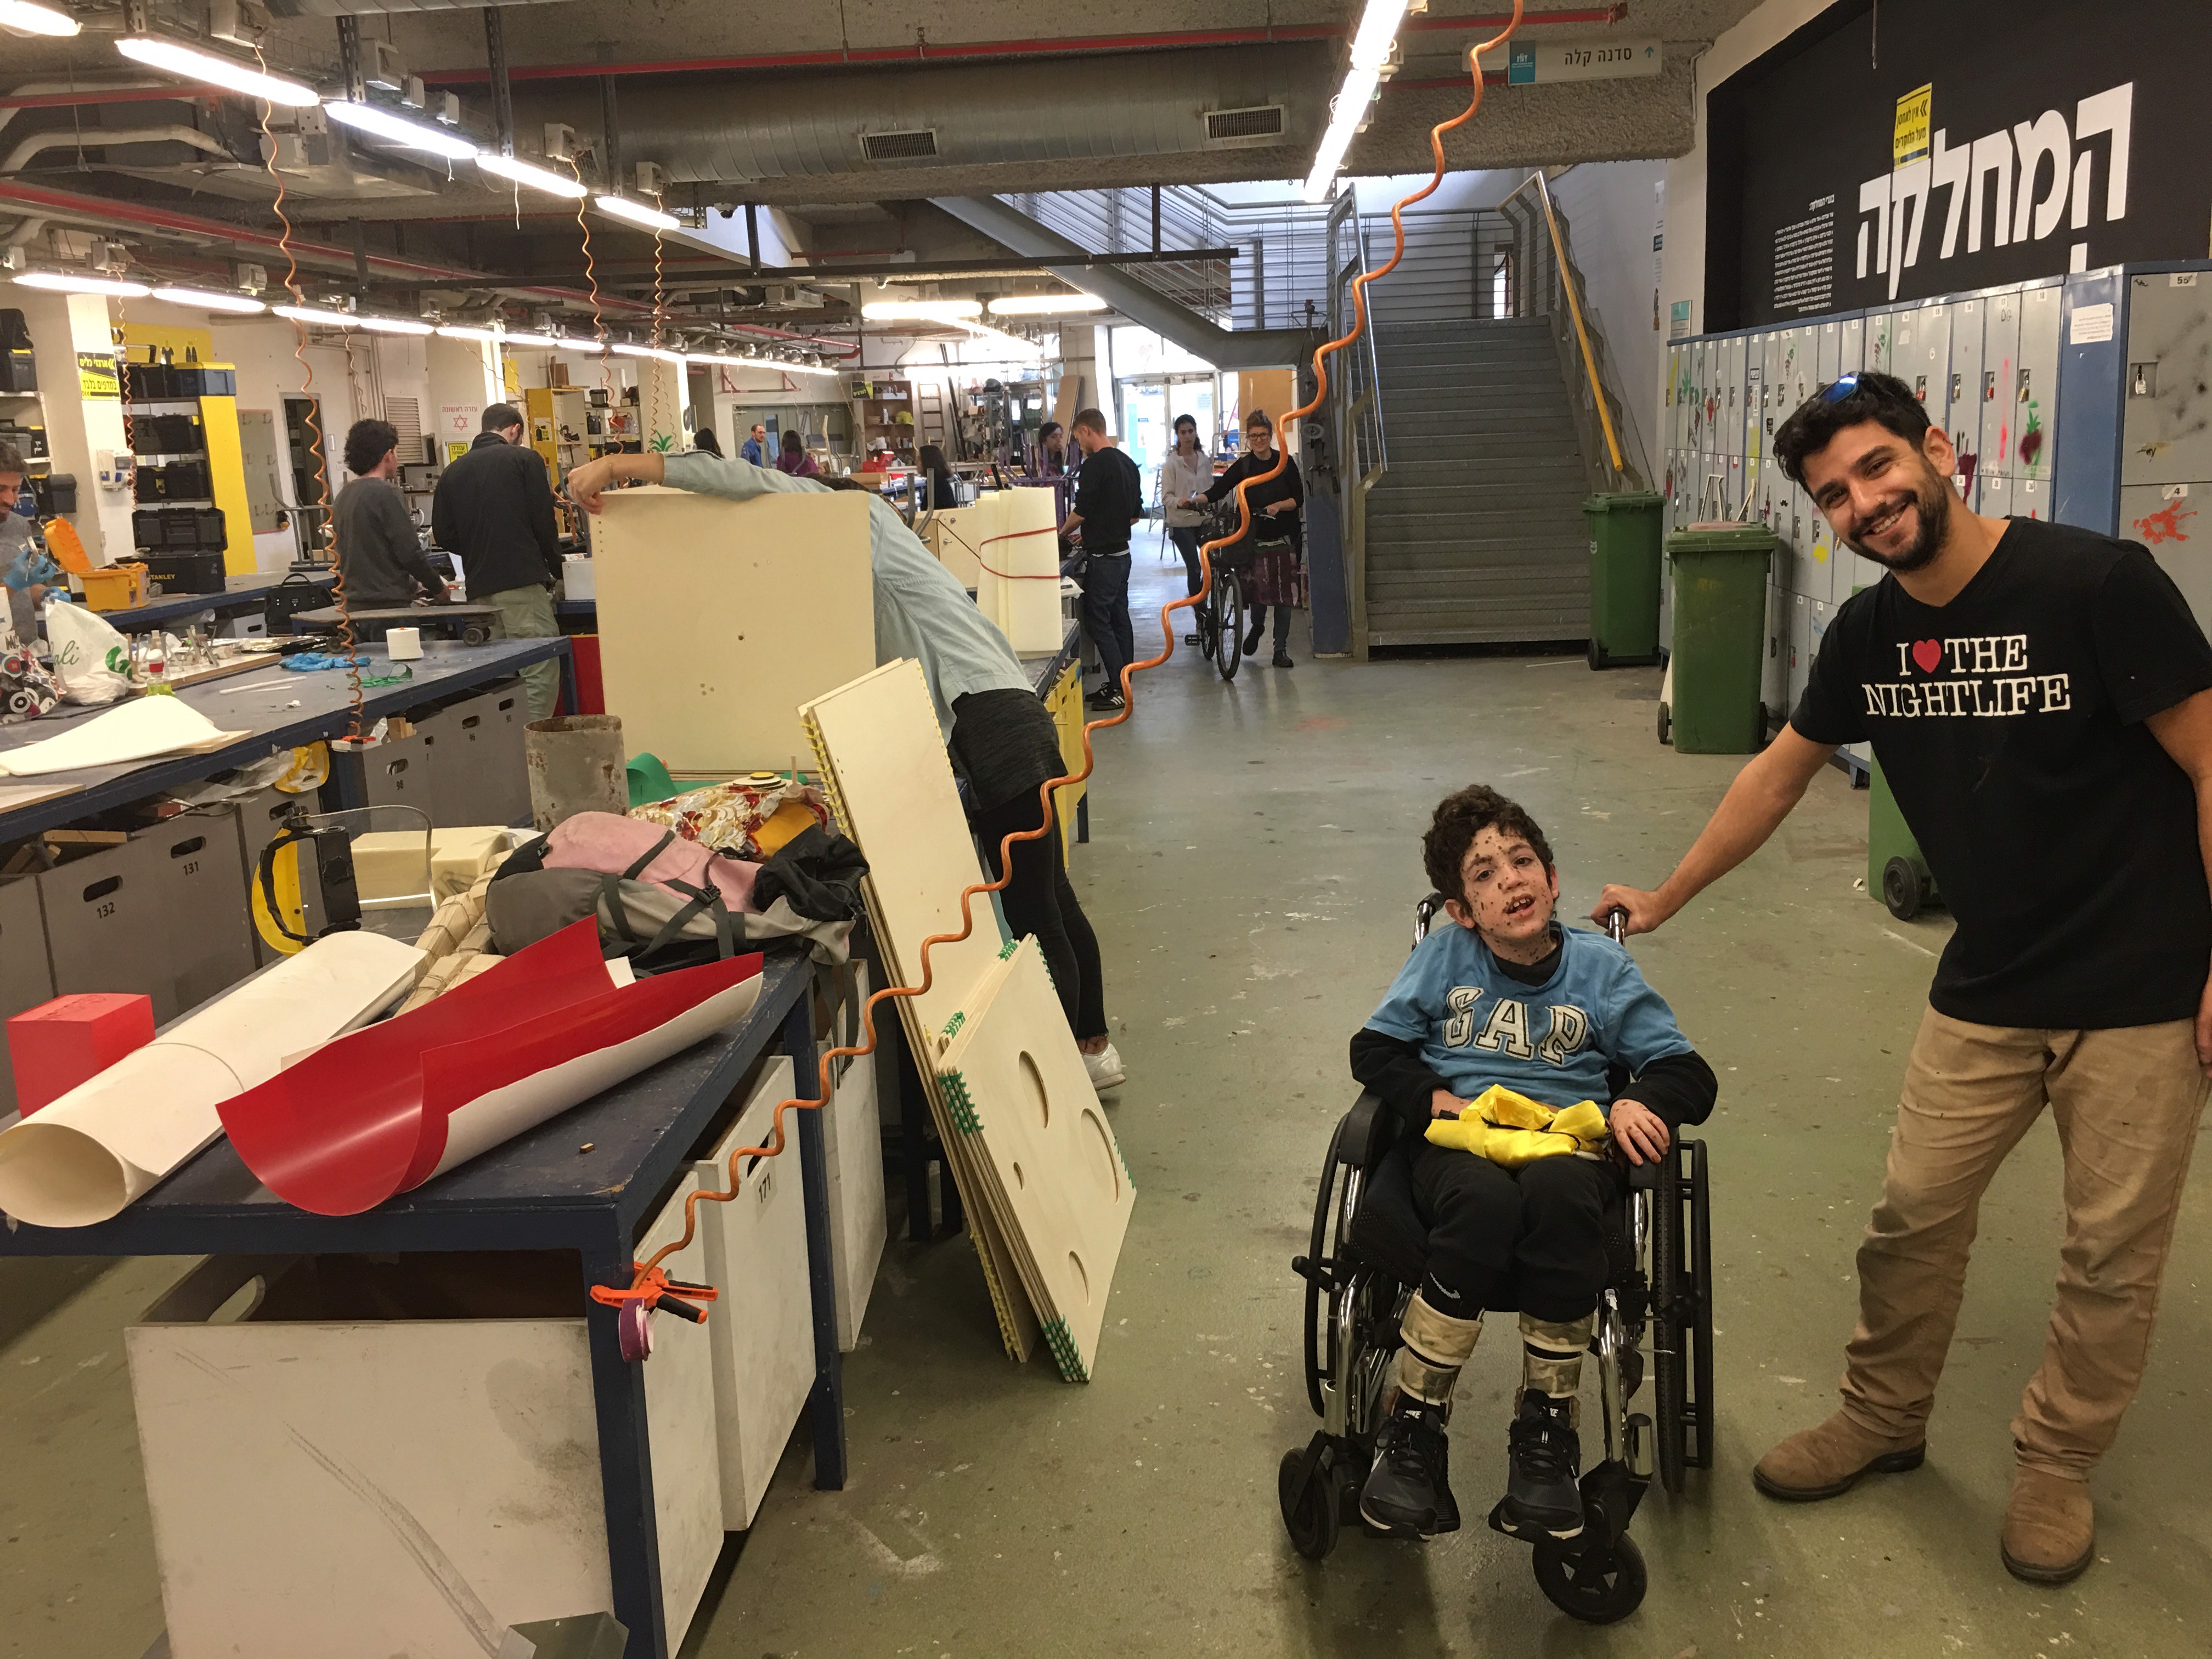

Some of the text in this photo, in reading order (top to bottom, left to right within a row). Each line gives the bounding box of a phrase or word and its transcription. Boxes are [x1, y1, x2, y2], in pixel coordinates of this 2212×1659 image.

[1565, 48, 1632, 67] סדנה קלה
[1896, 106, 1911, 129] לאחסן
[1895, 126, 1926, 149] מעל הלוקרים
[82, 377, 117, 390] במדפים בלבד
[1896, 634, 2028, 676] I THE
[1861, 673, 2071, 718] NIGHTLIFE
[396, 780, 404, 790] 98
[183, 861, 199, 876] 131
[97, 901, 115, 919] 132
